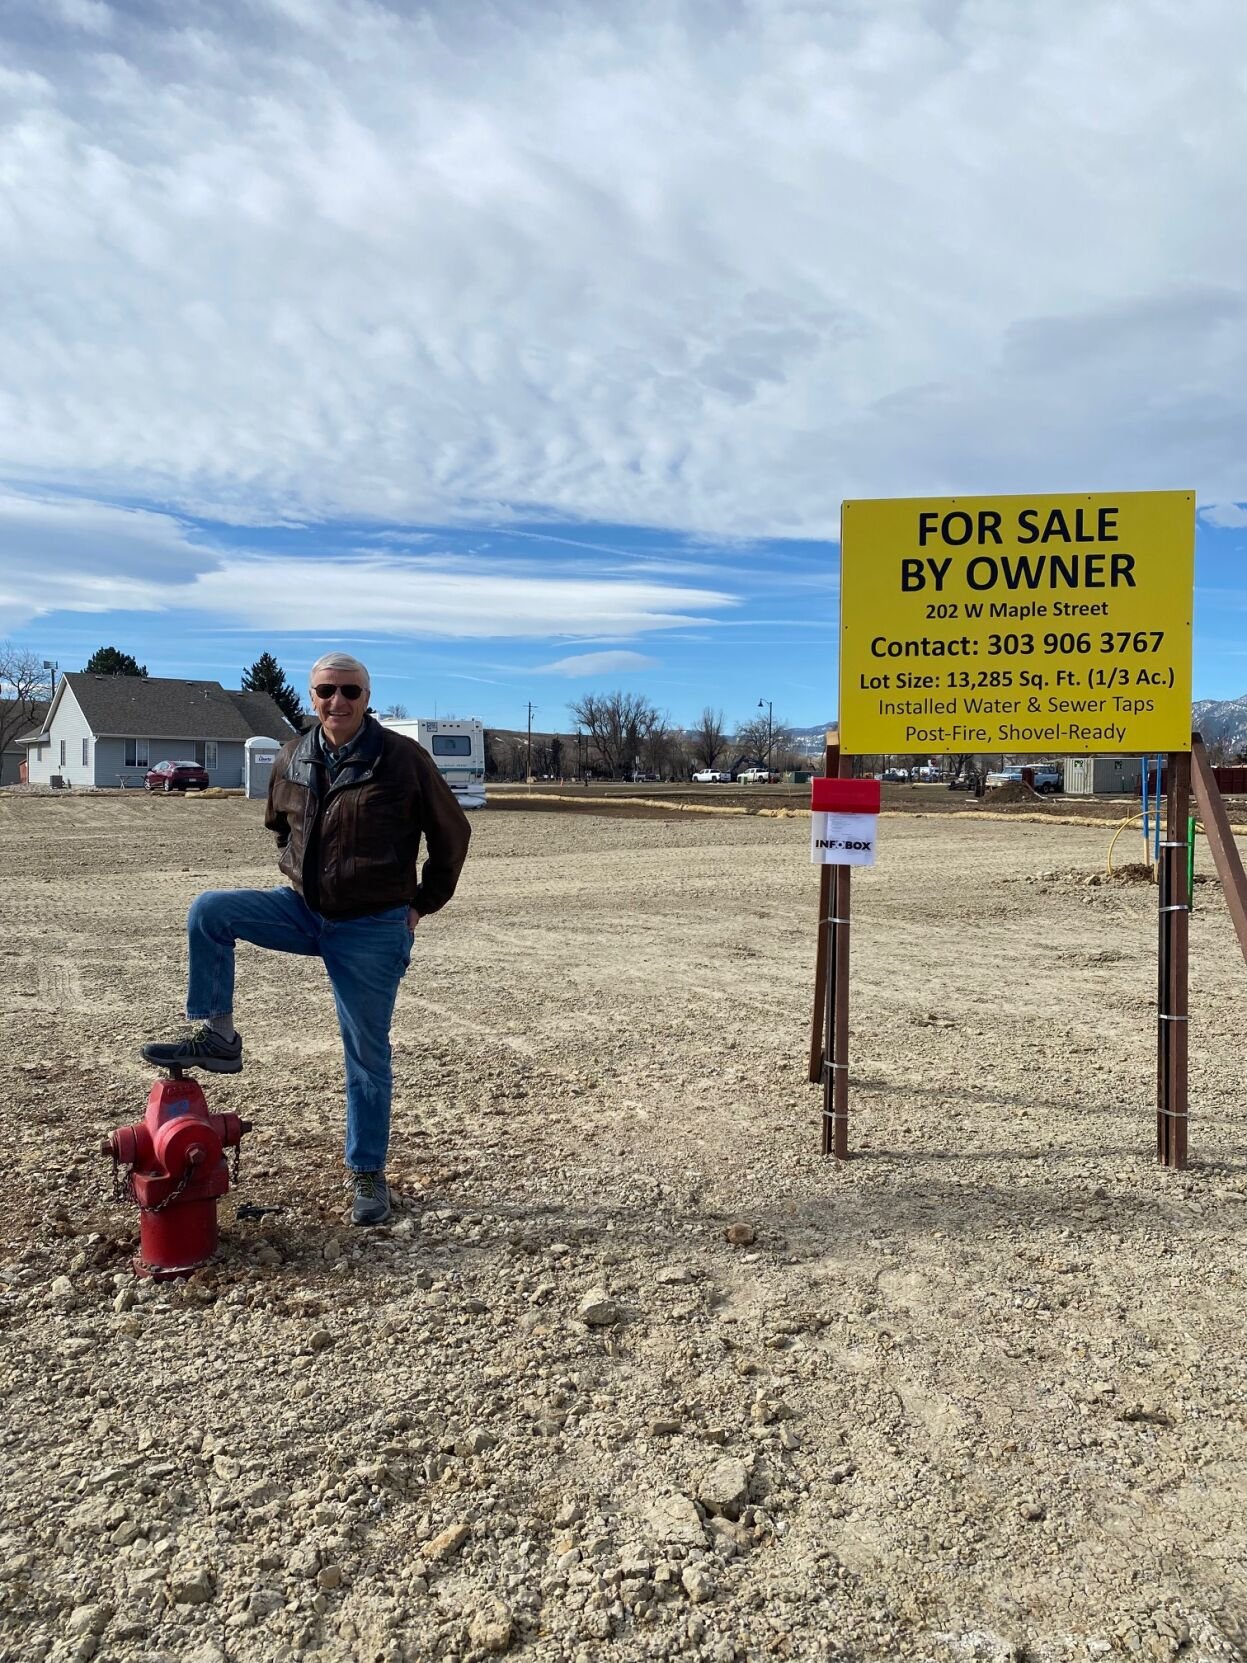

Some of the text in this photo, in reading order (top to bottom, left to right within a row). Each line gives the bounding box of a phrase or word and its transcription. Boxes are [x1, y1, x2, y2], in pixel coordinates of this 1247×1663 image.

[918, 507, 1119, 547] FOR SALE
[901, 553, 1137, 593] BY OWNER
[925, 600, 1109, 621] 202 W Maple Street
[870, 631, 1165, 658] Contact: 303 906 3767
[860, 666, 1175, 691] Lot Size: 13,285 Sq. Ft. (1/3 Ac.)
[879, 696, 1154, 716] Installed Water & Sewer Taps
[906, 722, 1127, 744] Post-Fire, Shovel-Ready
